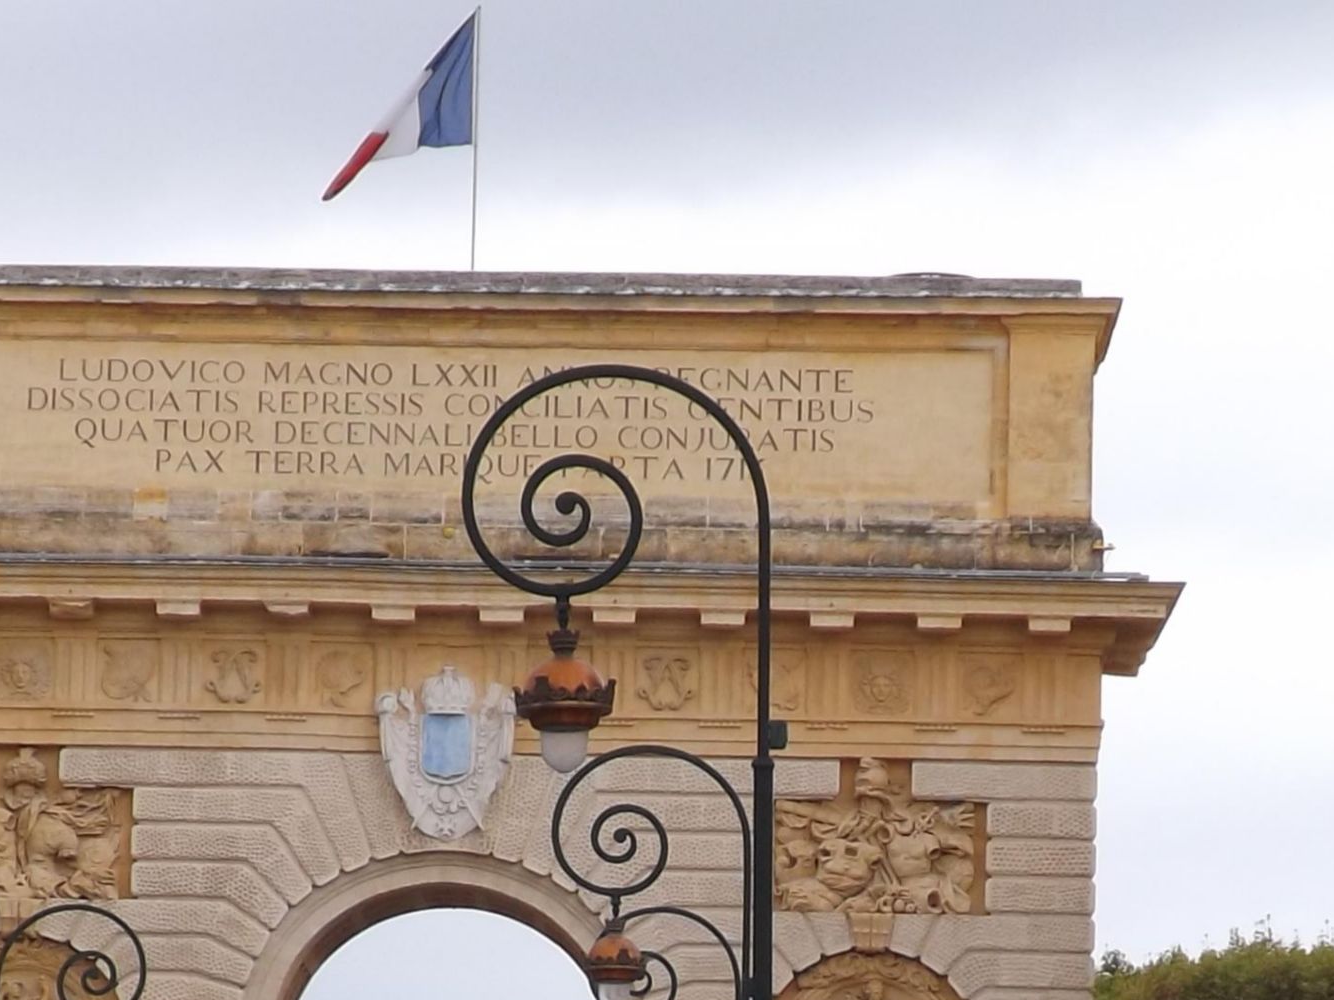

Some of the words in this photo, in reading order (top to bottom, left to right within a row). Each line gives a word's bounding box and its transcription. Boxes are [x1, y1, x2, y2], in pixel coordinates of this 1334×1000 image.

[59, 358, 246, 383] LUDOVICO
[264, 361, 393, 386] MAGNO
[411, 363, 497, 388] LXXII
[27, 387, 240, 414] DISSOCIATIS
[258, 390, 425, 417] REPRESSIS
[444, 393, 668, 420] CONCILIATIS
[74, 417, 255, 448] QUATUOR
[274, 421, 471, 447] DECENNALI
[491, 424, 598, 449] BELLO
[155, 448, 224, 474] PAX
[245, 449, 365, 475] TERRA
[383, 452, 542, 484] MARIQUE
[563, 455, 685, 480] RTA
[706, 457, 765, 481] 171
